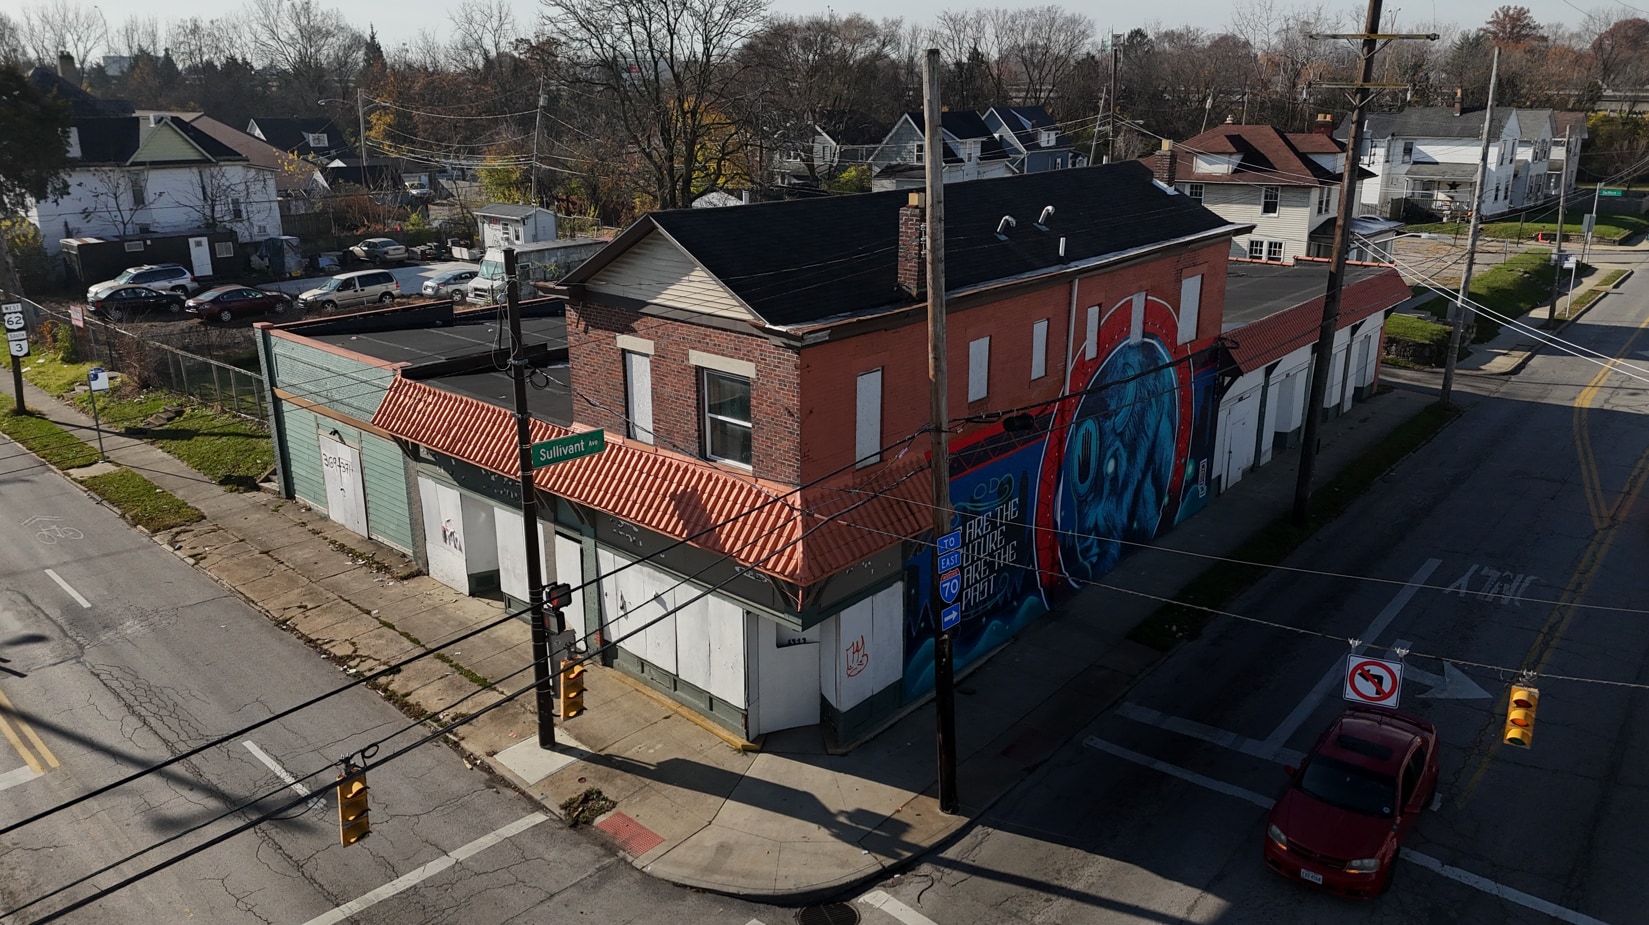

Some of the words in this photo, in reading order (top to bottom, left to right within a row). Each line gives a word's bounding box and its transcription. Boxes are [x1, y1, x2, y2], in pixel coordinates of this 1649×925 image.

[4, 304, 20, 312] WEST
[6, 316, 23, 326] 62
[15, 343, 24, 353] 3
[540, 440, 585, 461] Sullivant
[966, 511, 992, 543] ARE
[995, 498, 1019, 527] THE
[943, 537, 955, 549] TO
[961, 526, 1006, 567] UTURE
[941, 554, 958, 569] EAST
[964, 556, 990, 589] ARE
[994, 540, 1017, 571] THE
[942, 578, 959, 598] 70
[962, 573, 997, 611] PAST
